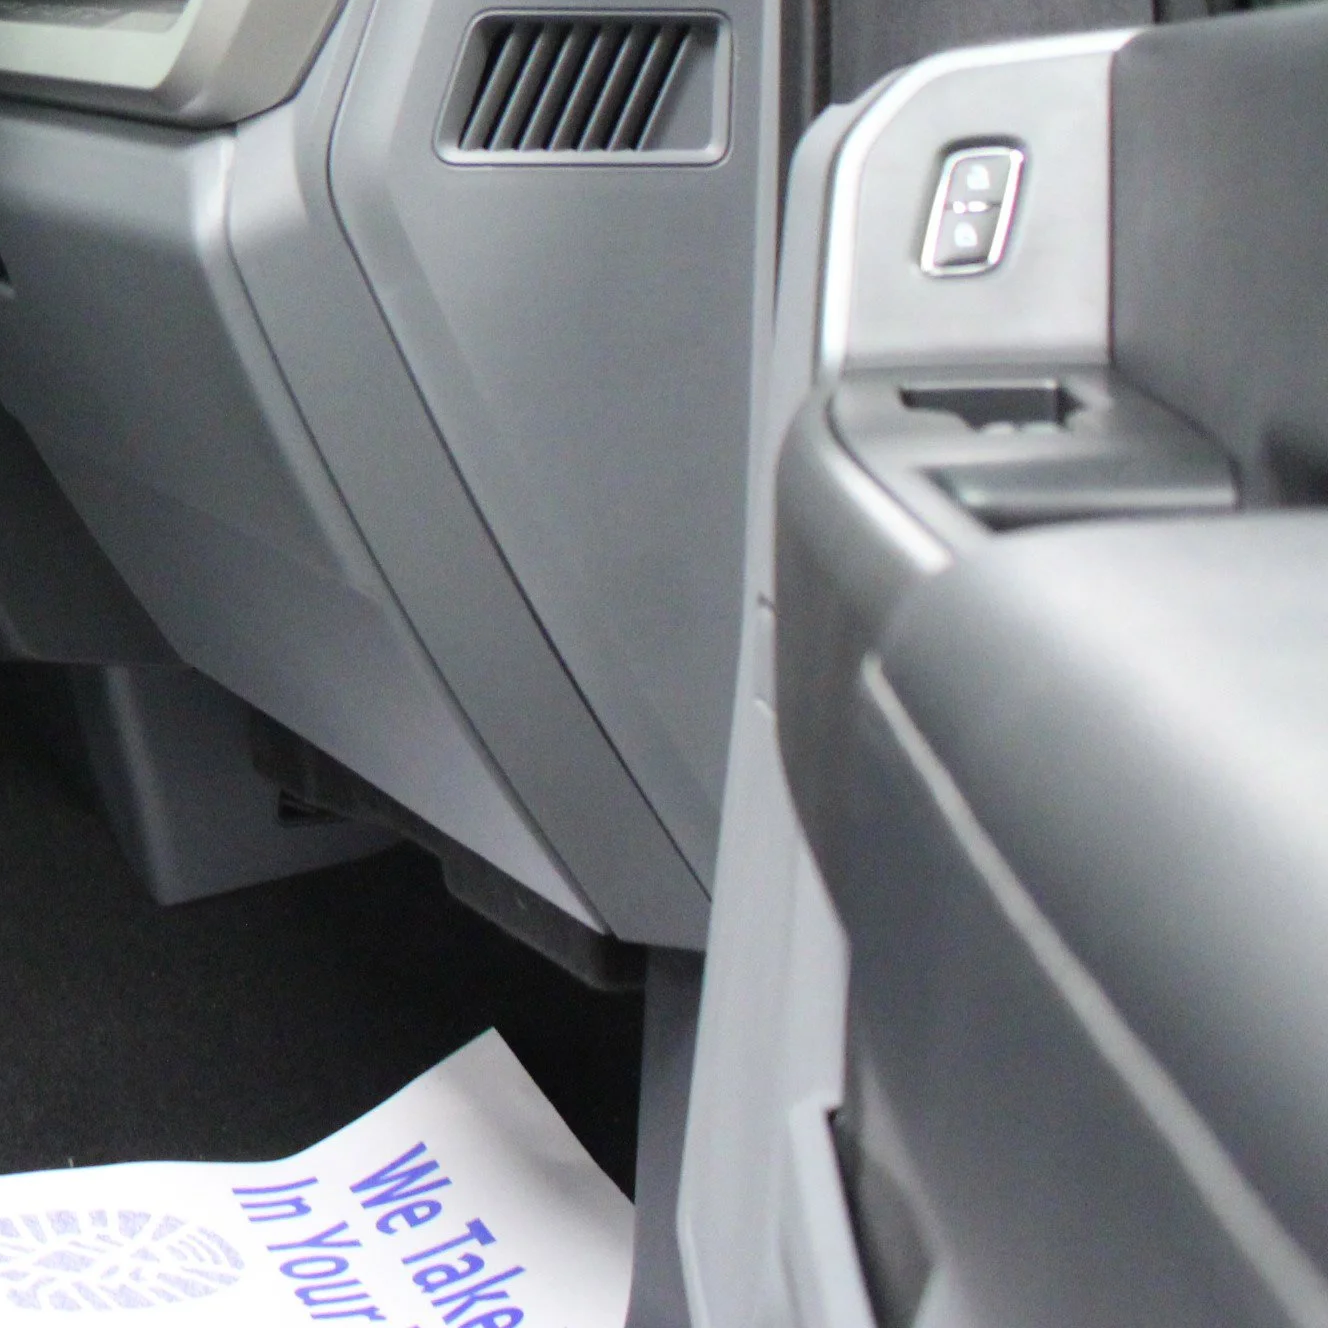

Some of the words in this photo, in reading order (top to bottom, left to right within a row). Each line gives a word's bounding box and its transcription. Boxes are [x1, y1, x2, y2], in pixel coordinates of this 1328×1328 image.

[231, 1175, 320, 1223] In
[348, 1140, 453, 1235] We
[266, 1220, 387, 1322] Your
